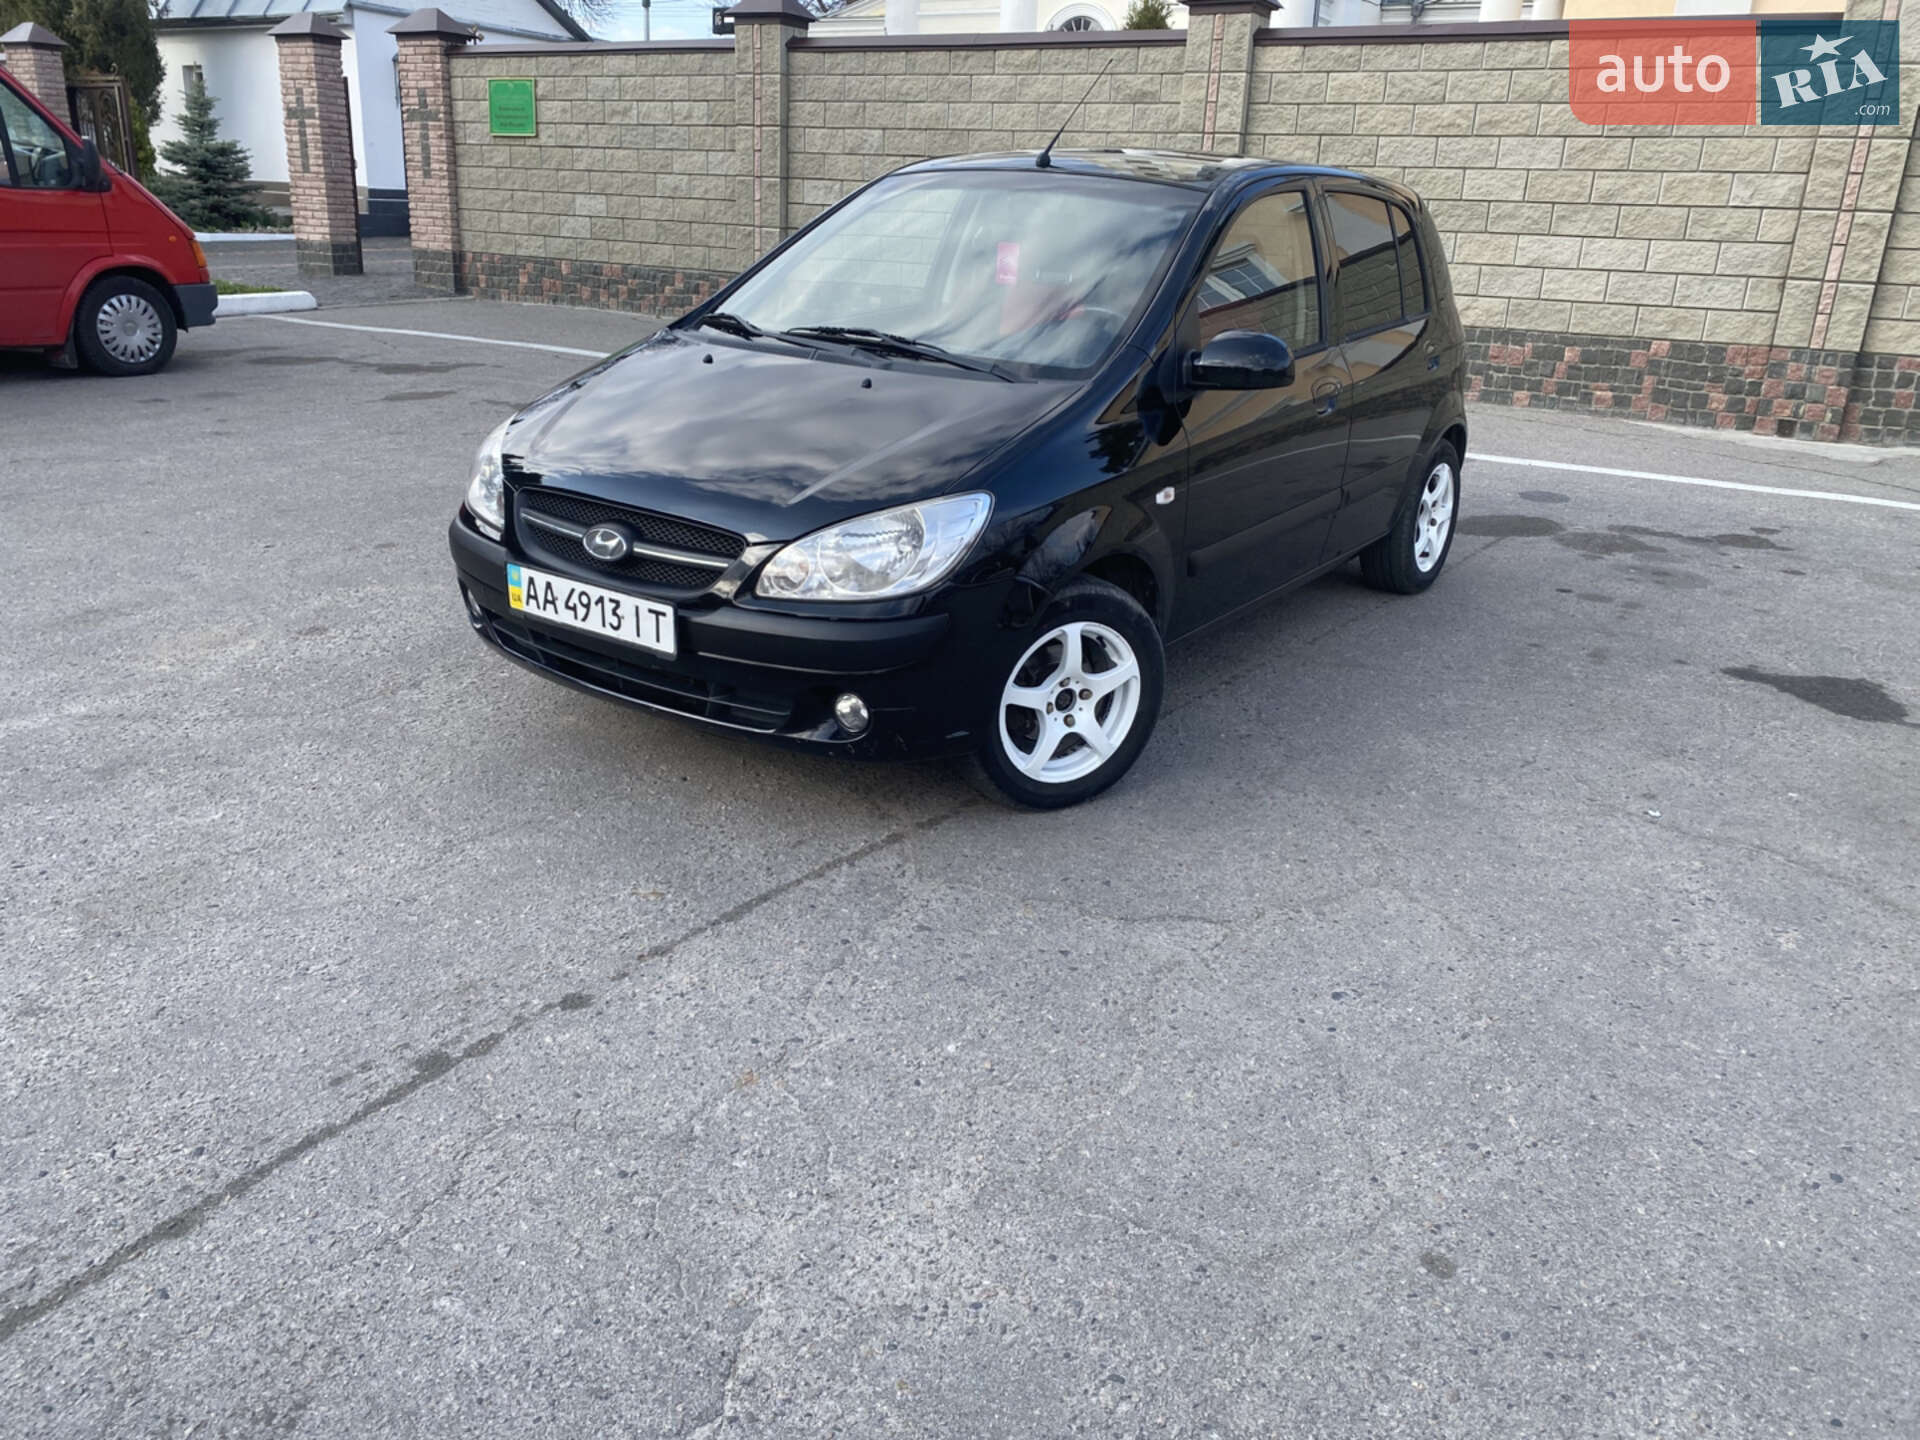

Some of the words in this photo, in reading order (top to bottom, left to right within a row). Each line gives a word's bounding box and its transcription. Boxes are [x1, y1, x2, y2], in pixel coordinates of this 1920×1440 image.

[525, 576, 559, 615] AA
[564, 587, 622, 632] 4913
[634, 604, 667, 644] IT
